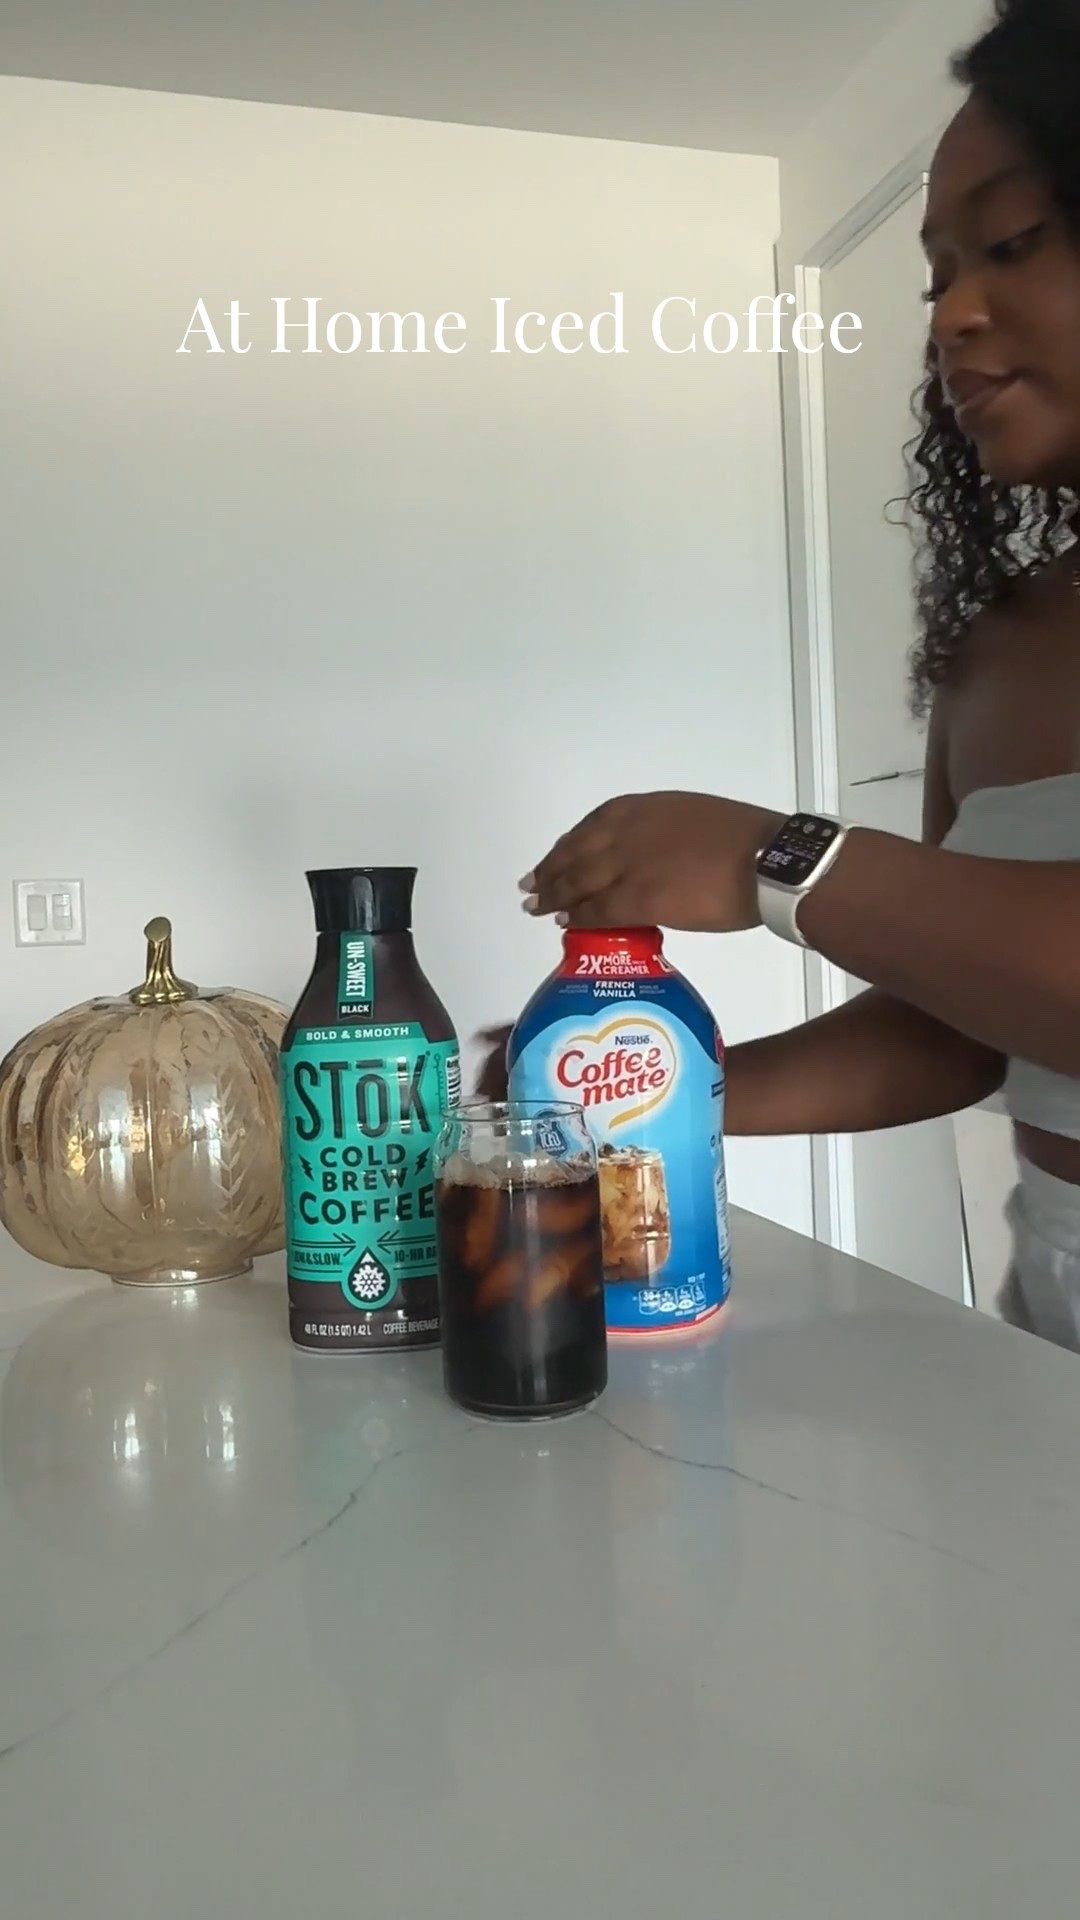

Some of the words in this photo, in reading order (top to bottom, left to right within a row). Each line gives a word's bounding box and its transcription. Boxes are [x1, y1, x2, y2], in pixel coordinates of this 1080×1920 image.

[575, 954, 603, 975] 2X
[603, 953, 632, 966] MORE
[346, 941, 366, 997] UN-SWEET
[602, 965, 650, 975] CREAMER
[593, 989, 636, 998] VANILLA
[595, 981, 635, 989] FRENCH
[341, 1004, 370, 1014] BLACK
[306, 1030, 337, 1041] BOLD
[341, 1028, 352, 1039] &
[354, 1026, 409, 1038] SMOOTH
[557, 1047, 662, 1088] Coffee
[582, 1067, 667, 1108] mate
[320, 1143, 407, 1168] COLD
[322, 1167, 409, 1193] BREW
[299, 1183, 434, 1225] COFFEE
[319, 1324, 328, 1336] OZ
[352, 1324, 366, 1336] 1.42
[367, 1324, 372, 1336] L
[383, 1321, 408, 1335] COFFEE
[408, 1317, 440, 1333] BEVERAGE
